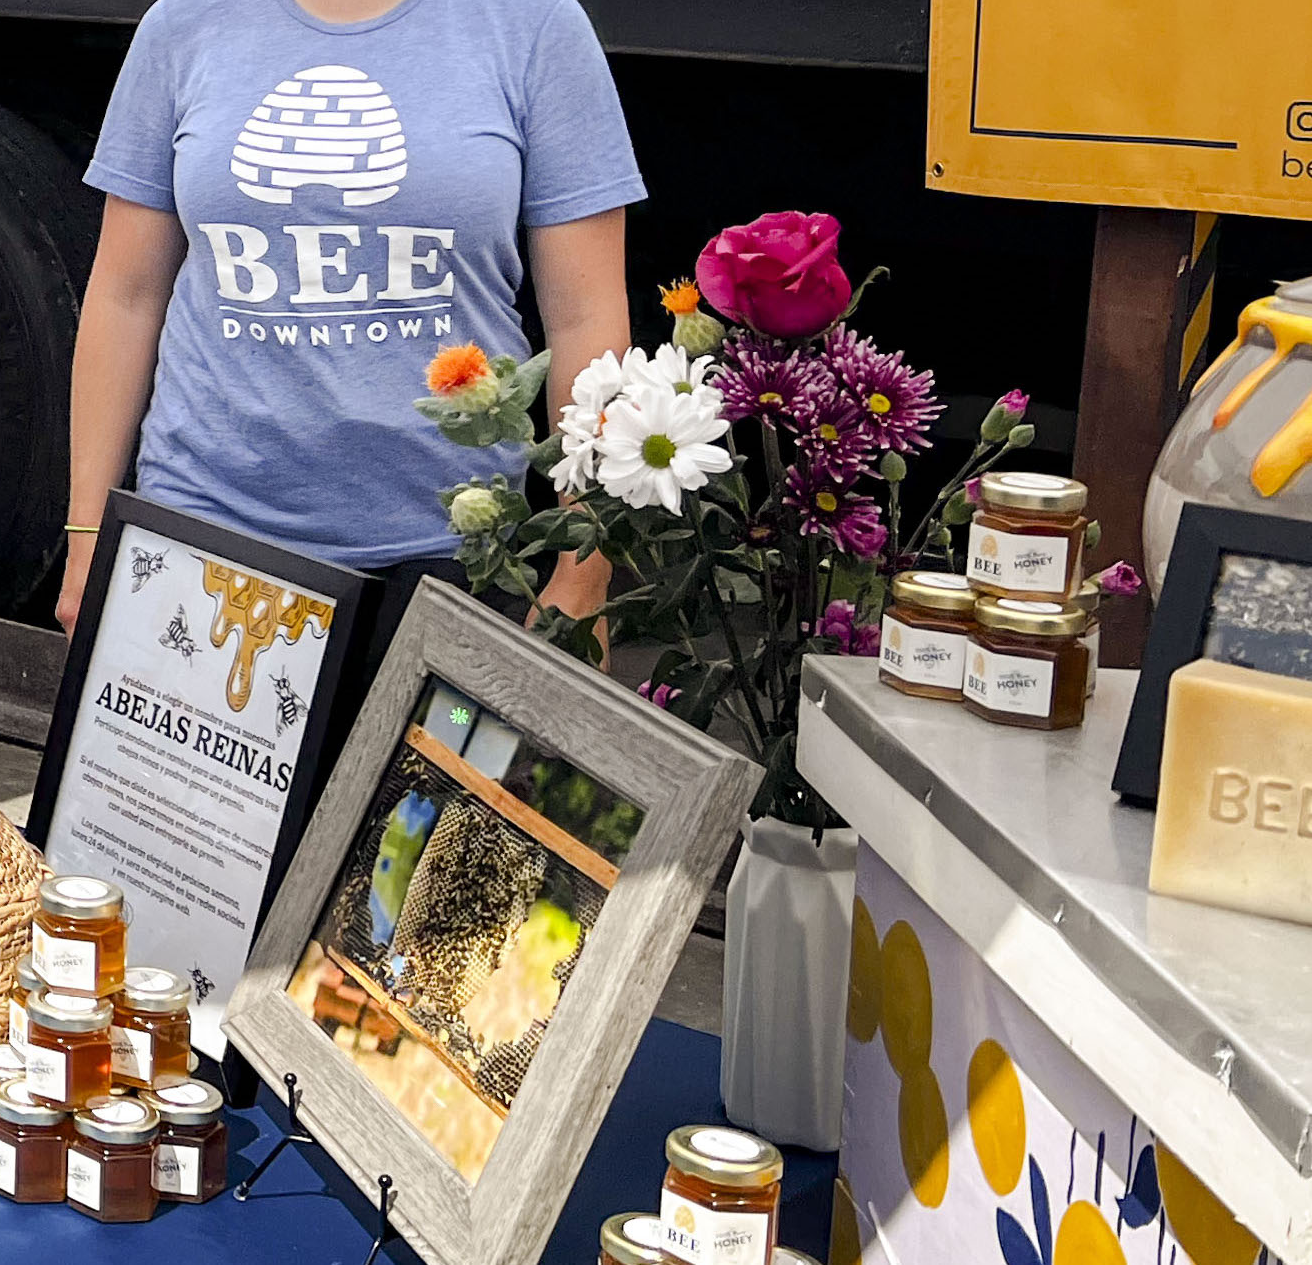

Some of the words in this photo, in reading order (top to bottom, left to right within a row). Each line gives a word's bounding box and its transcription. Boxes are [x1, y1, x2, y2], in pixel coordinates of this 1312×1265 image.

[198, 222, 456, 305] BEE
[222, 314, 453, 346] DOWNTOWN
[974, 557, 1002, 577] BEE
[1014, 556, 1053, 570] HONEY
[884, 650, 904, 667] BEE
[913, 652, 953, 663] HONEY
[968, 676, 987, 696] BEE
[997, 678, 1037, 690] HONEY
[96, 683, 190, 743] ABEJAS
[193, 725, 291, 791] REINAS
[667, 1228, 701, 1254] BEE
[714, 1234, 753, 1250] HONEY
